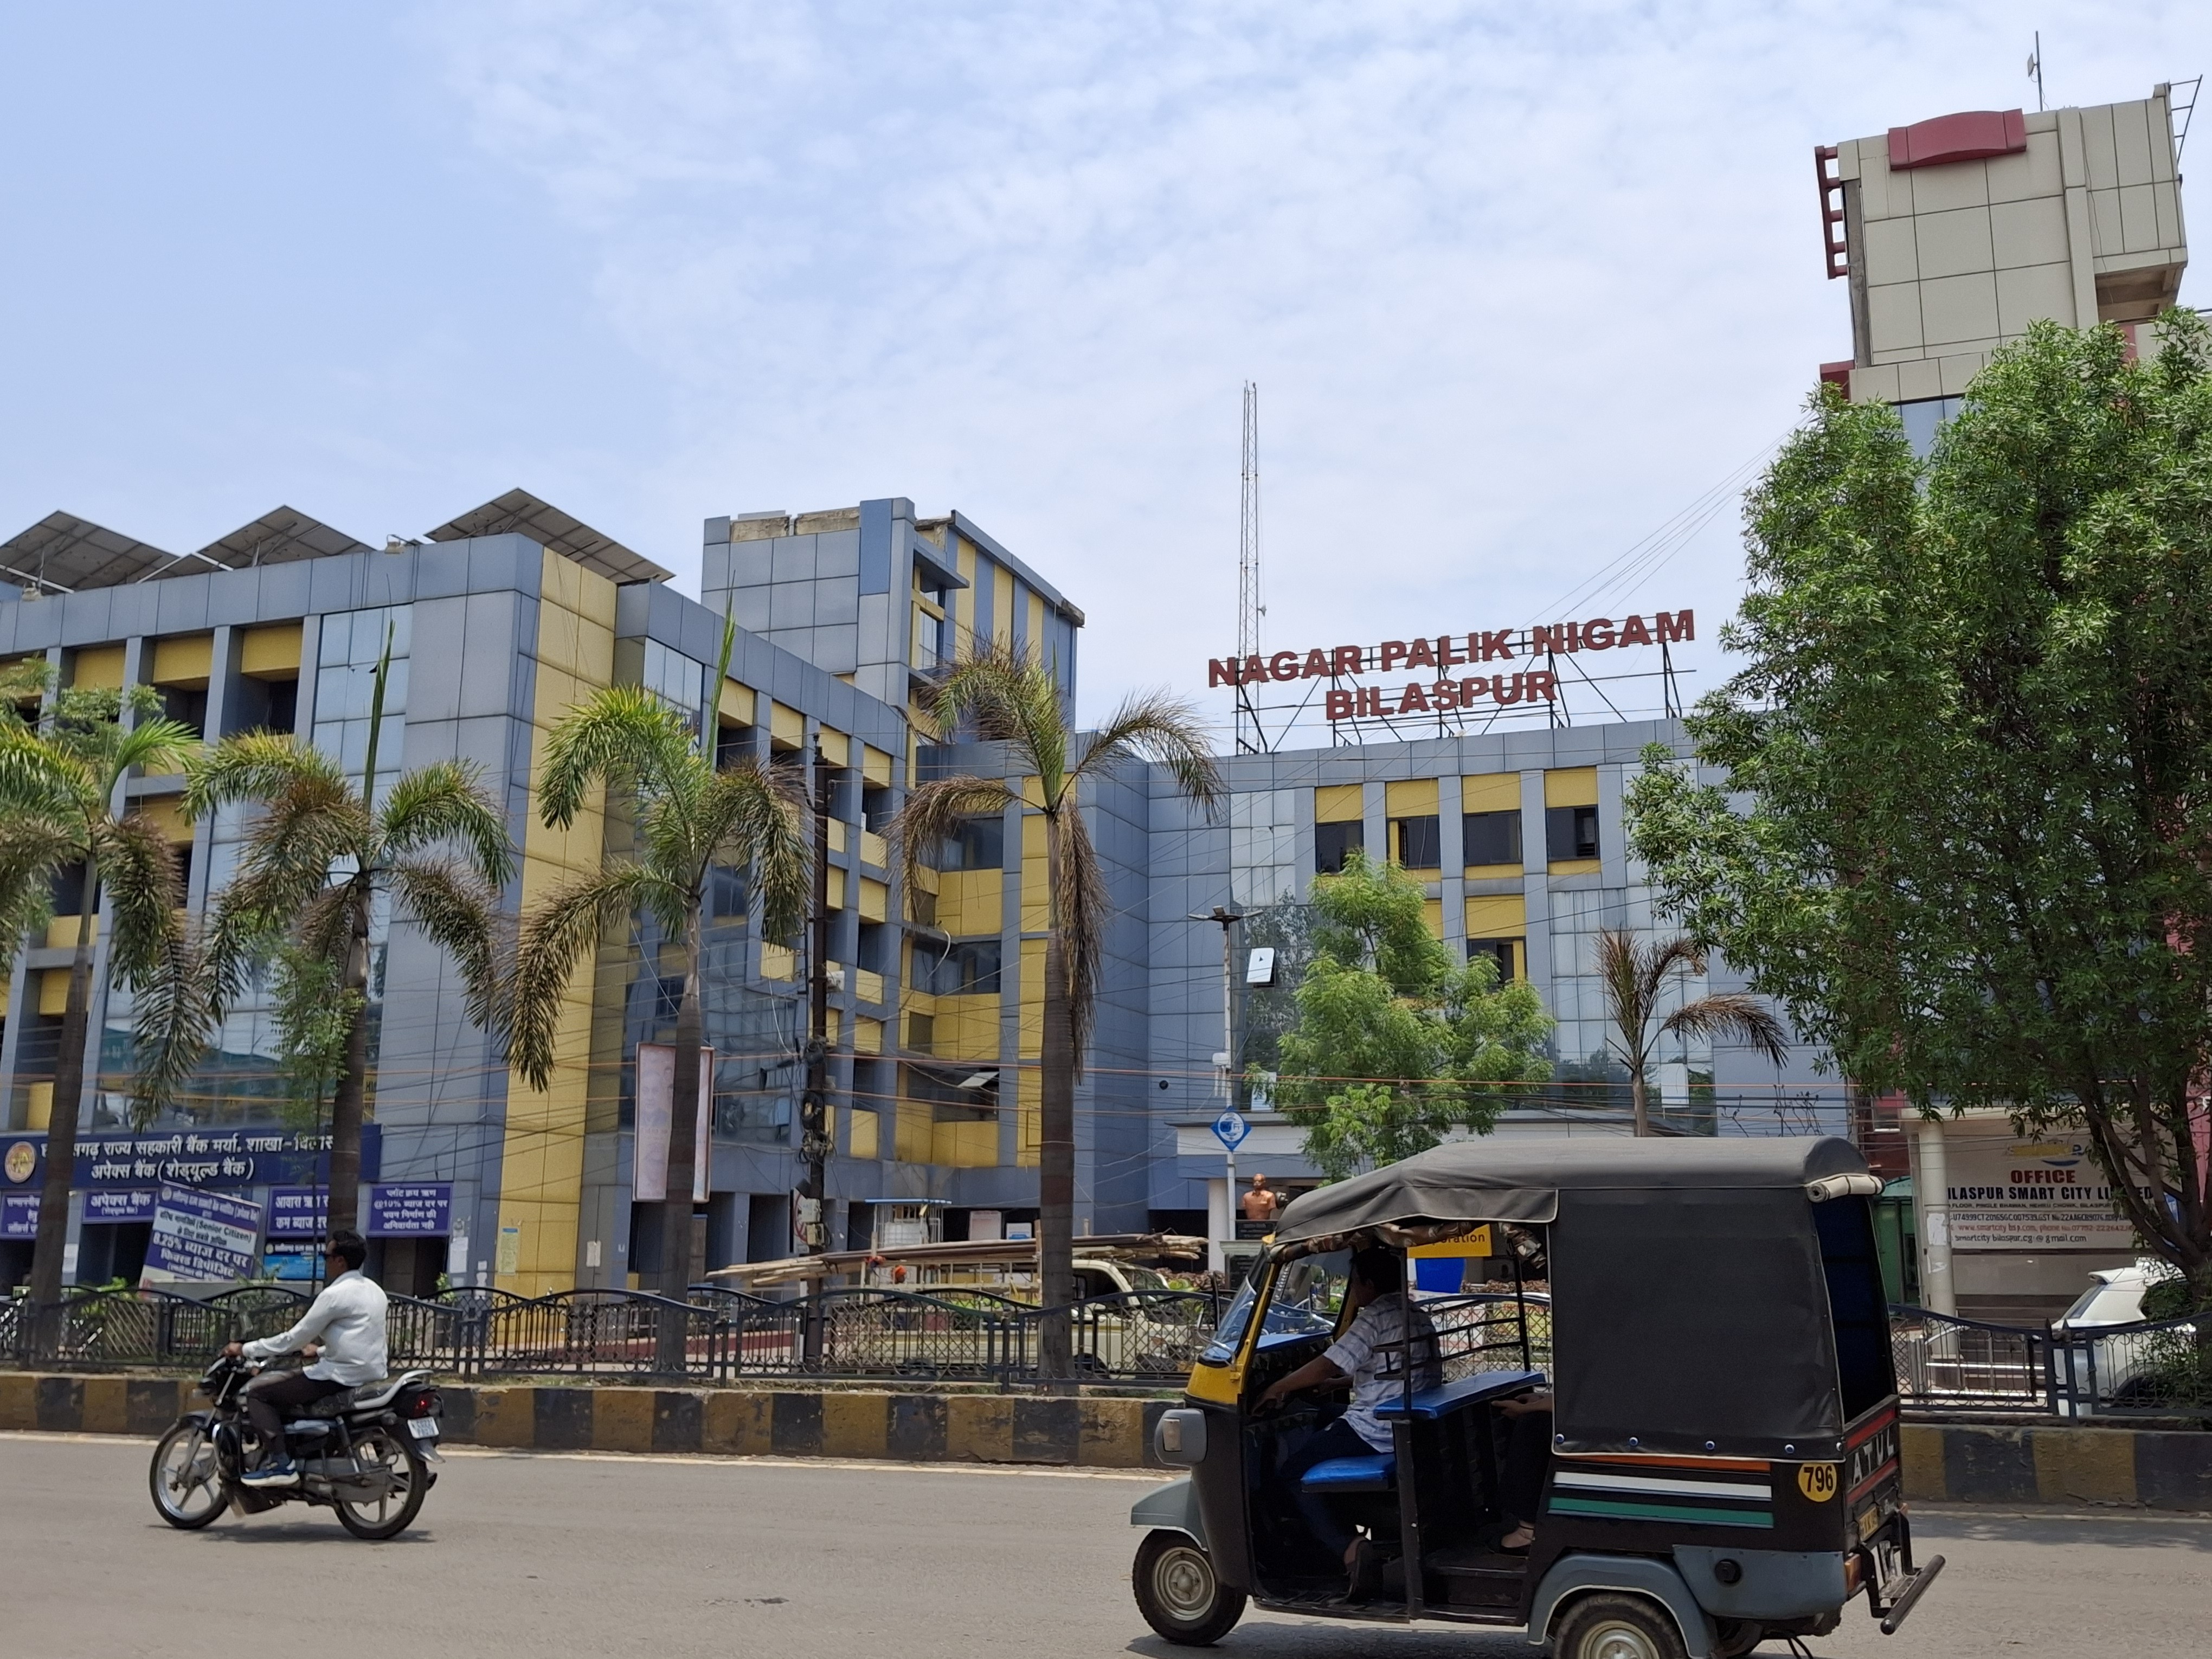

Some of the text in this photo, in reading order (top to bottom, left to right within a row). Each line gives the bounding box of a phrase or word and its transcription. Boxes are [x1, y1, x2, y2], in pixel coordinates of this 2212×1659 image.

[1209, 609, 1695, 687] NAGAR PALIK NIGAM
[1326, 671, 1557, 720] BILASPUR
[103, 1141, 132, 1156] राज्य
[135, 1135, 183, 1157] सहकारी
[185, 1134, 209, 1155] बैंक
[91, 1158, 131, 1180] अपेक्स
[134, 1158, 156, 1179] बैंक
[2010, 1169, 2076, 1184] OFFICE
[1947, 1187, 2004, 1200] ILASPUR
[2009, 1186, 2055, 1200] SMART
[2061, 1186, 2092, 1200] CITY
[1853, 1427, 1894, 1487] ATUL
[1803, 1465, 1834, 1492] 796
